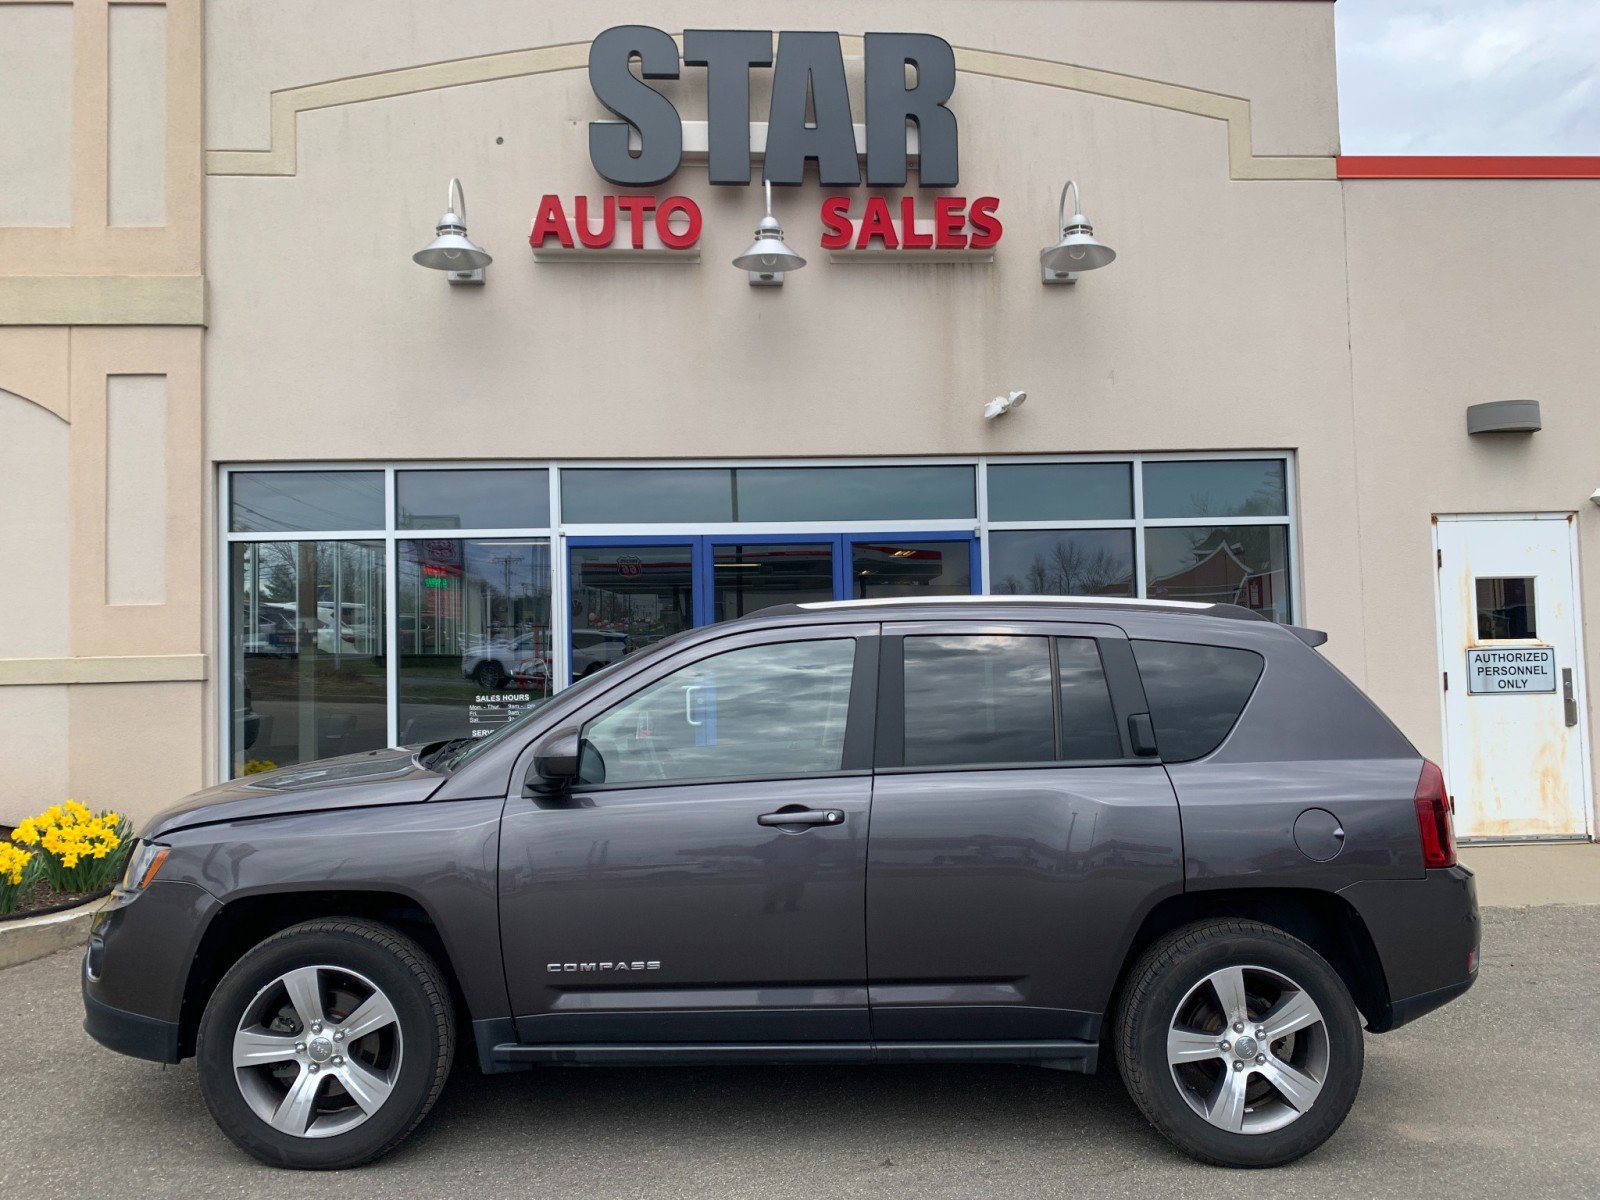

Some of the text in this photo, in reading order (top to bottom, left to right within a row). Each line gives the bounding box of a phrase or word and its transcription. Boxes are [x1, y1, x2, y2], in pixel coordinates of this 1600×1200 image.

[589, 24, 959, 188] STAR
[528, 194, 1003, 250] AUTO SALES
[1474, 652, 1549, 663] AUTHORIZED
[1477, 666, 1548, 676] PERSONNEL
[1498, 679, 1528, 689] ONLY
[475, 693, 530, 702] SALES HOURS
[546, 961, 661, 973] COMPASS
